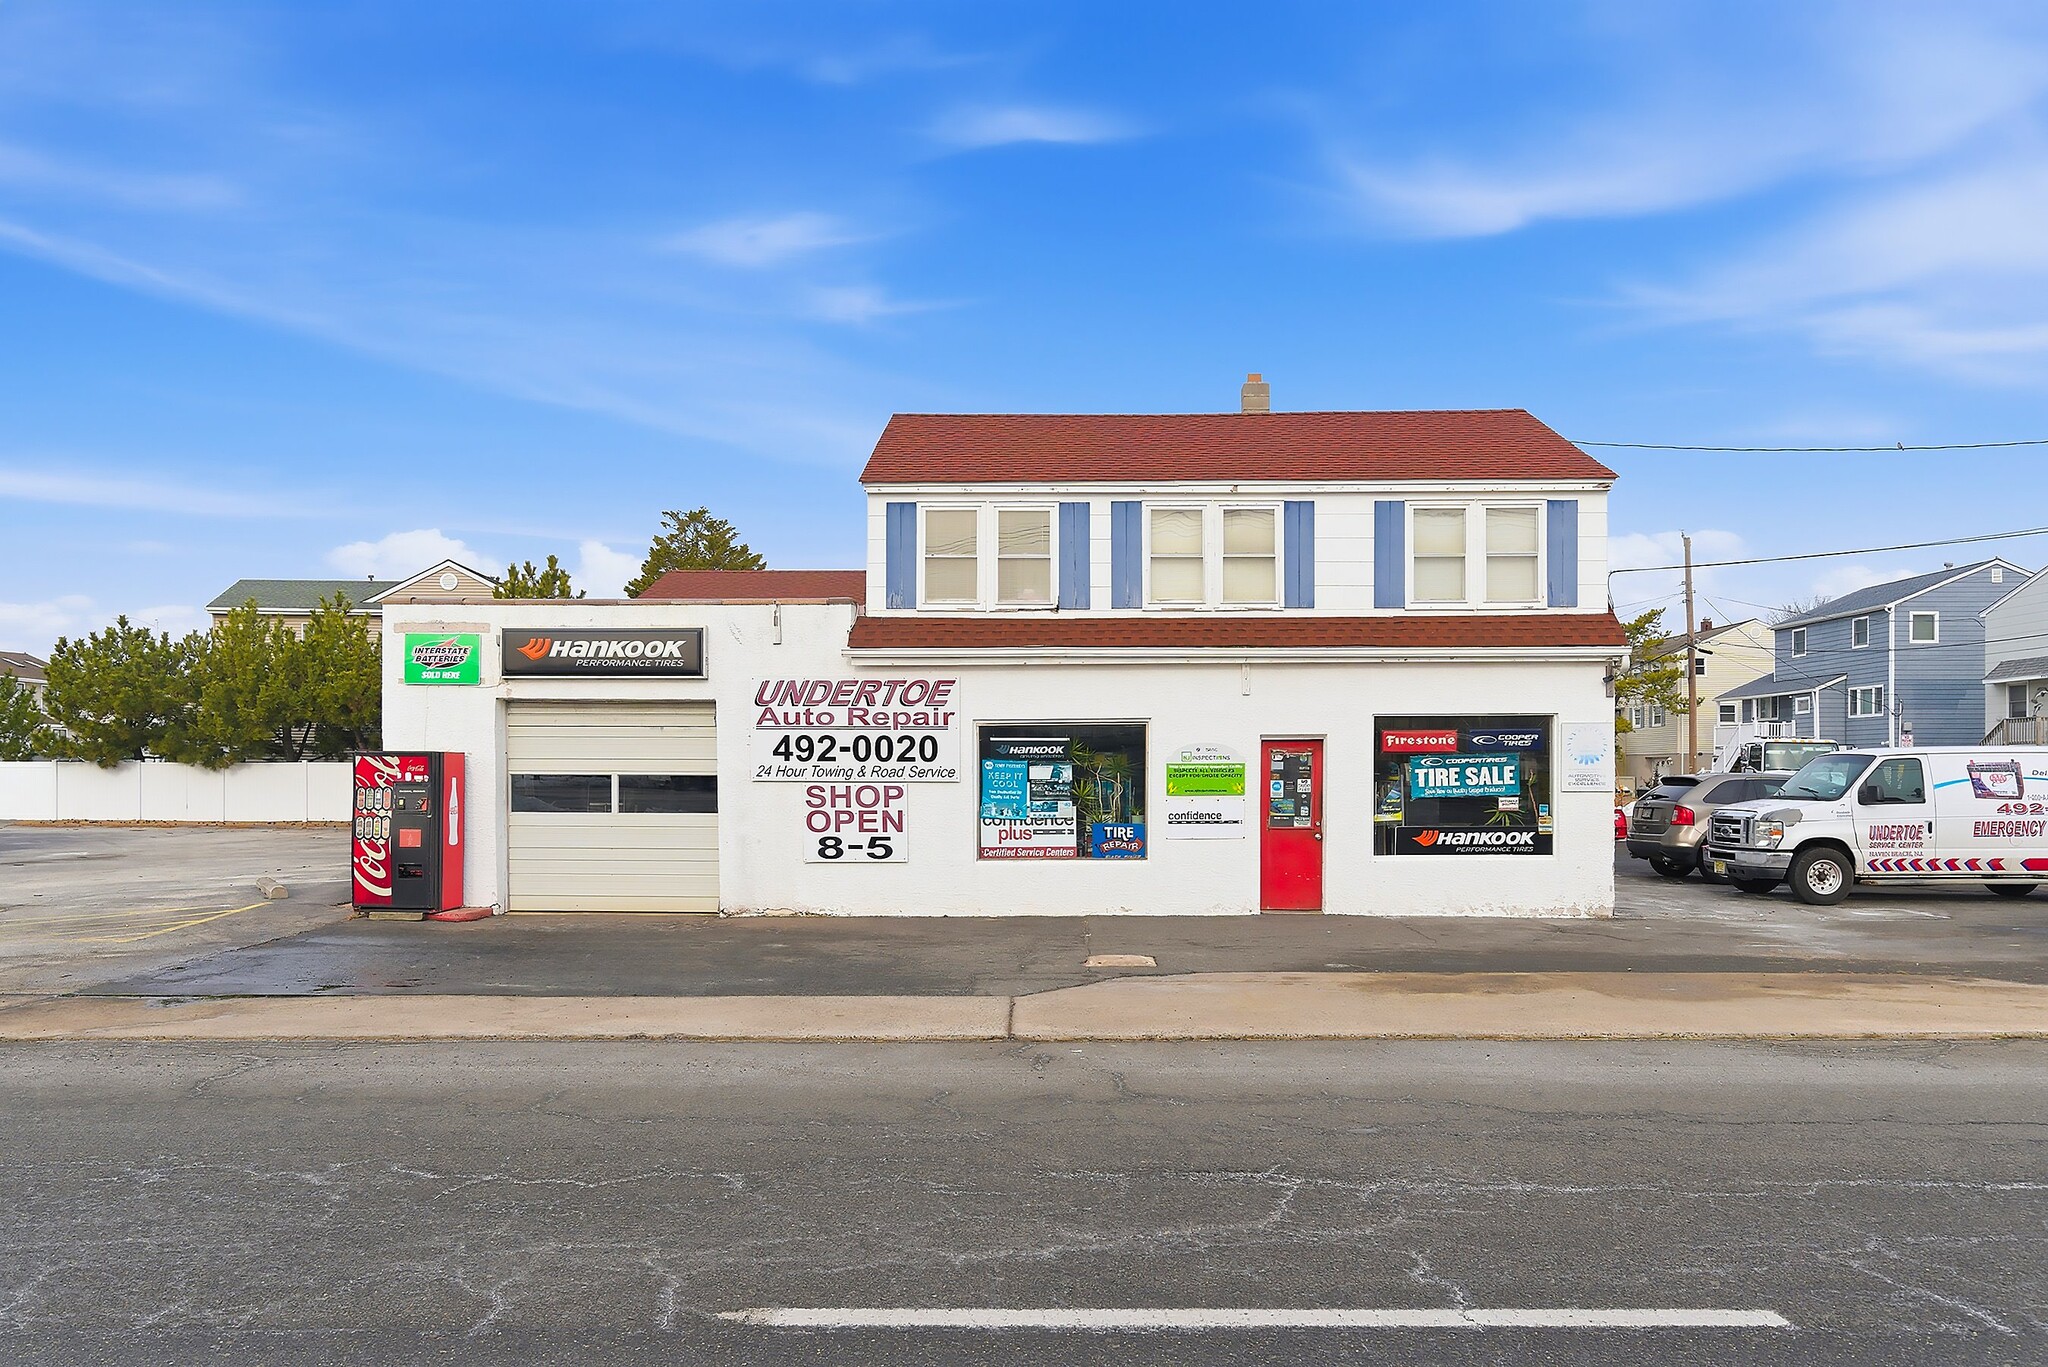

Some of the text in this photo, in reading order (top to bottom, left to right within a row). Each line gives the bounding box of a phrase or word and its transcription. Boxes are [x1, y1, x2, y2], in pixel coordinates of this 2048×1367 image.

[414, 647, 469, 655] INTERSTATE
[576, 659, 684, 667] PERFORMANCE TIRES
[421, 671, 461, 679] SOLD HERE
[755, 680, 956, 706] UNDERTOE
[756, 708, 955, 730] Auto Repair
[772, 735, 939, 762] 492-0020
[1386, 735, 1456, 746] Firestone
[756, 765, 956, 780] 24 Hour Towing & Road Service
[988, 771, 1023, 780] KEEP IT
[1414, 766, 1515, 787] TIRE SALE
[992, 780, 1019, 788] COOL
[805, 785, 904, 808] SHOP
[806, 810, 904, 832] OPEN
[1168, 811, 1222, 820] confidence
[998, 827, 1033, 844] plus
[1104, 826, 1134, 842] TIRE
[1869, 824, 1925, 841] UNDERTOE
[1973, 820, 2046, 837] EMERGENCY
[817, 836, 893, 859] 8-5
[984, 847, 1074, 857] Certified Service Centers
[1102, 841, 1139, 850] REPAIR
